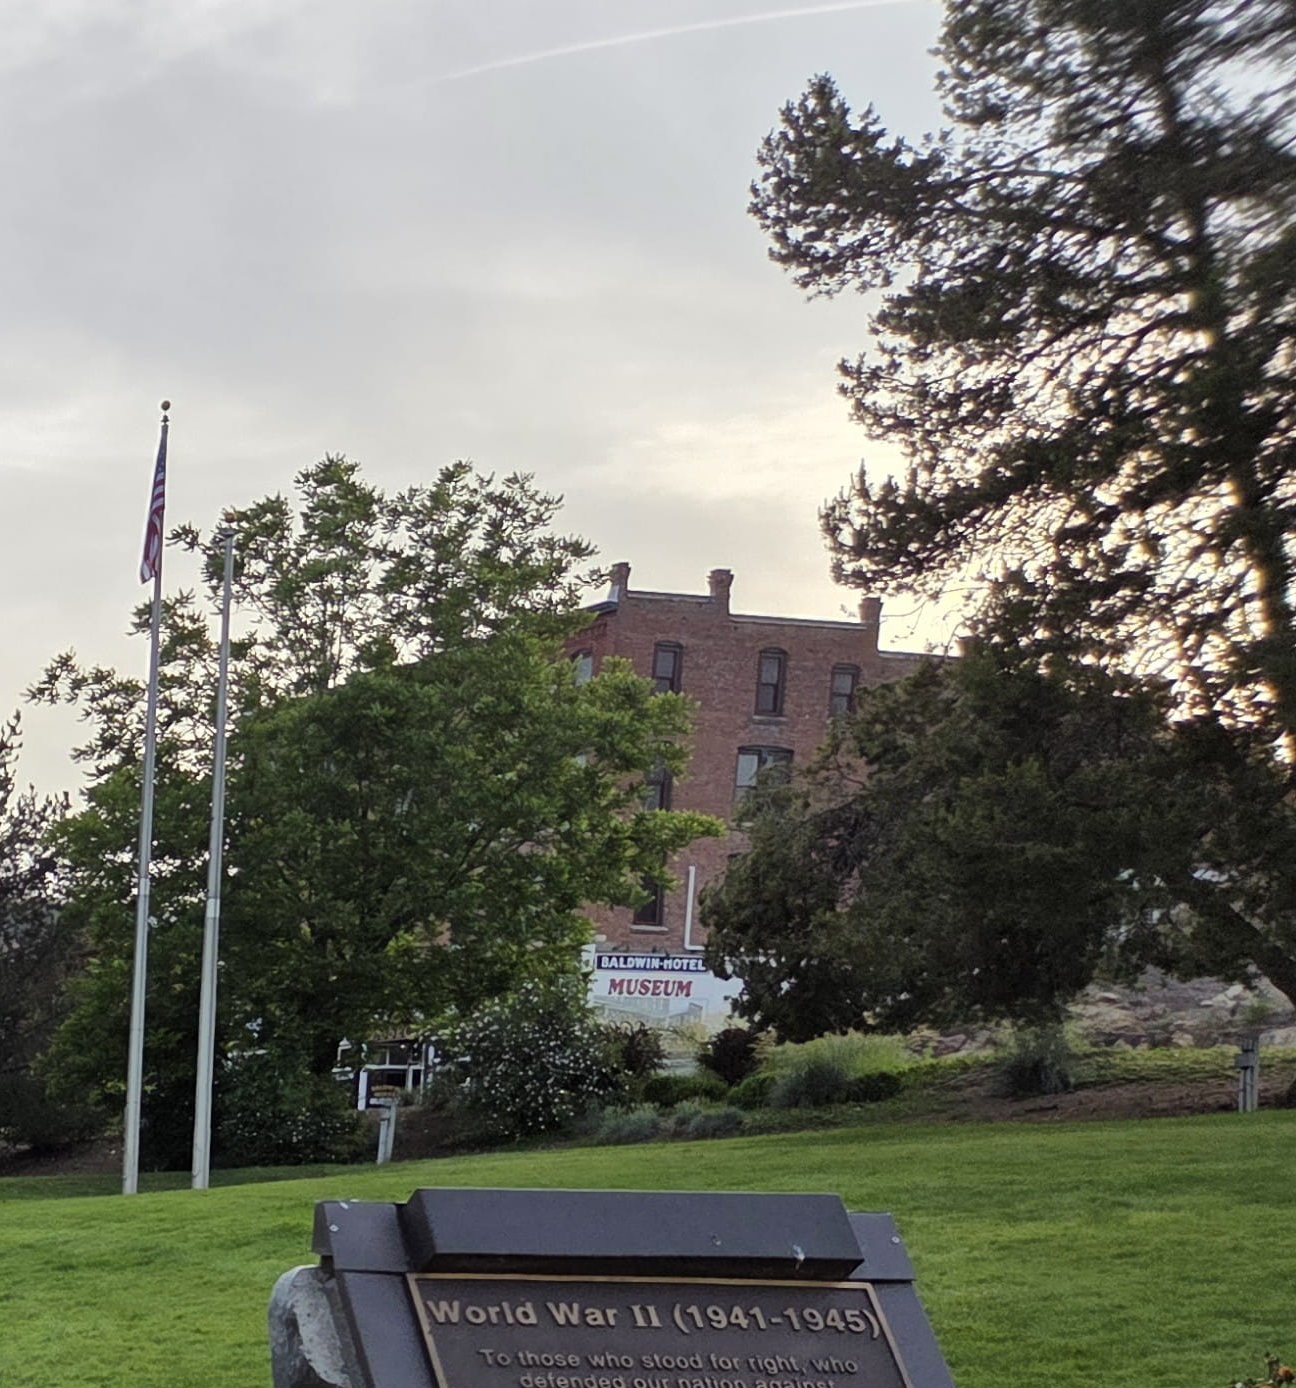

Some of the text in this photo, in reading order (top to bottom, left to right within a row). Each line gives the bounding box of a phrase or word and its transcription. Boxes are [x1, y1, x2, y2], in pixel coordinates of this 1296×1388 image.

[607, 978, 693, 997] MUSEUM
[428, 1300, 879, 1337] World War II (1941-1945)
